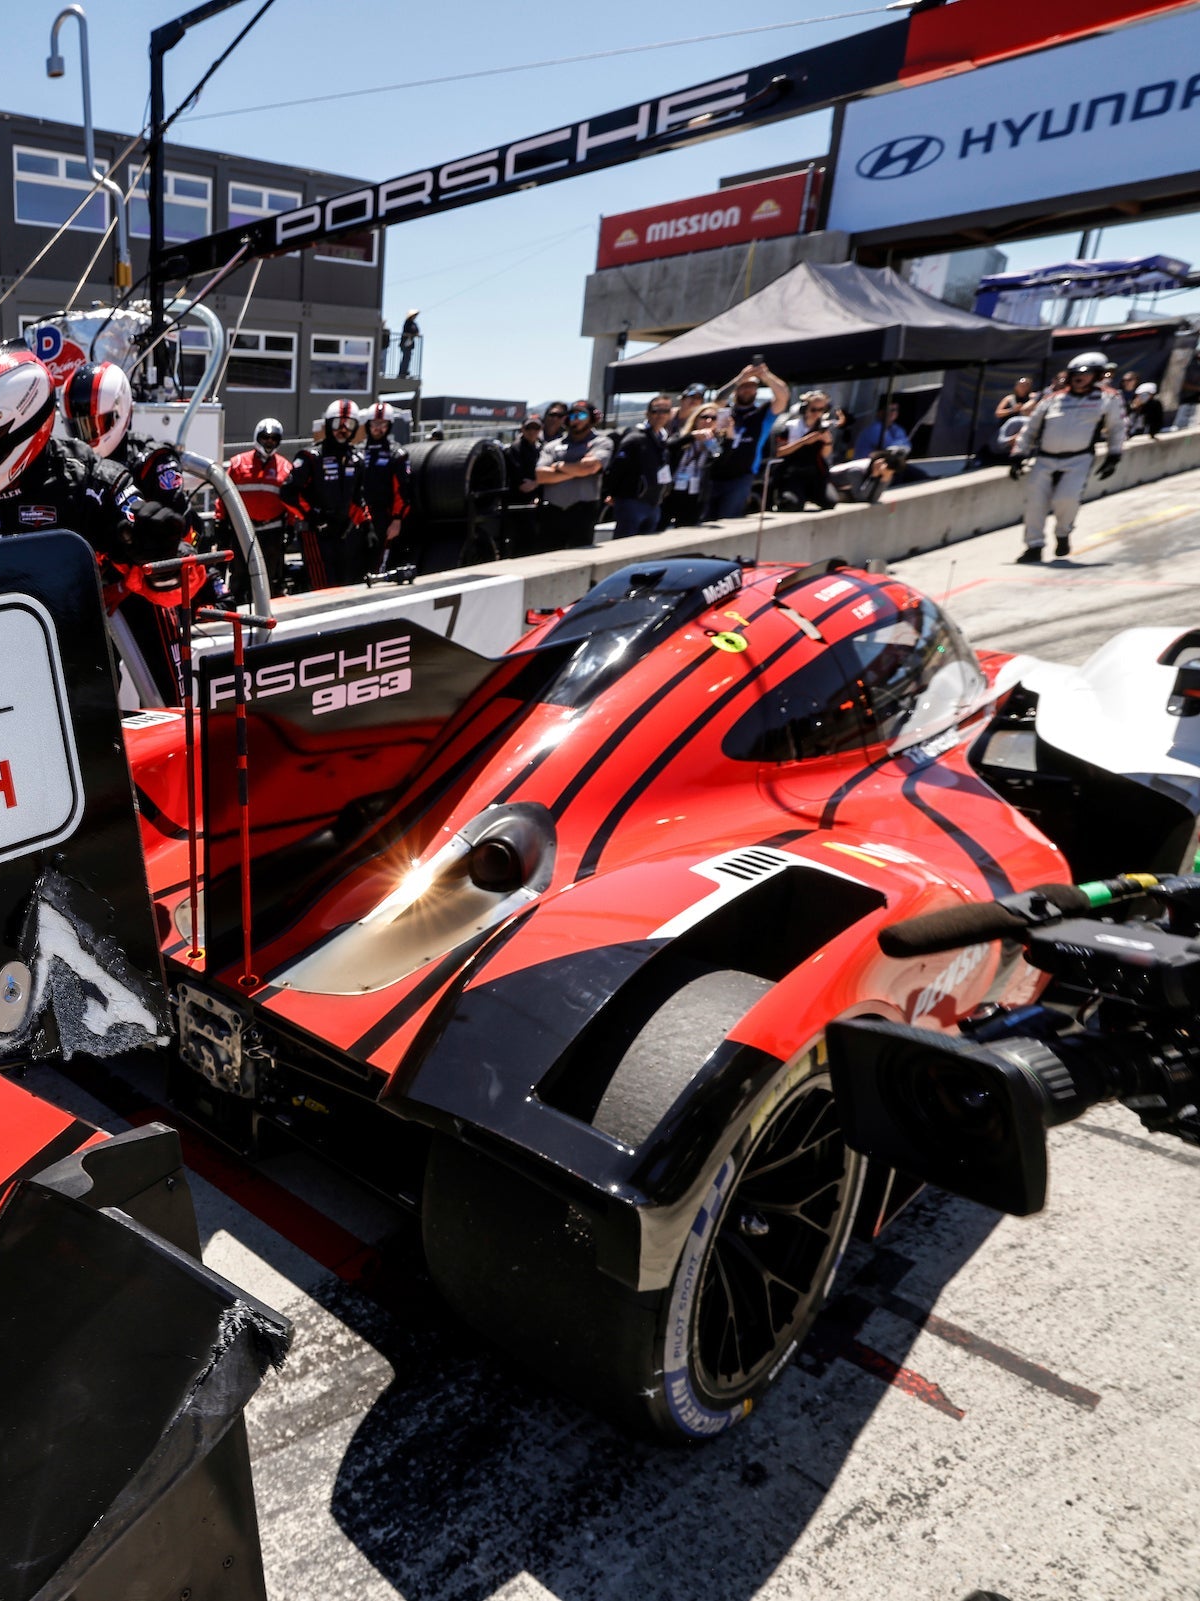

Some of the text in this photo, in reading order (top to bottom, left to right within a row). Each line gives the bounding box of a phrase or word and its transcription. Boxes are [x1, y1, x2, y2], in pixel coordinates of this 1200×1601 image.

[275, 73, 749, 245] PORSCHE
[646, 206, 741, 243] MISSION
[702, 573, 735, 604] Mobil
[433, 593, 462, 638] 7
[312, 668, 412, 715] 963
[673, 1256, 699, 1359] PILOT SPORT
[671, 1377, 728, 1434] MICHELIN
